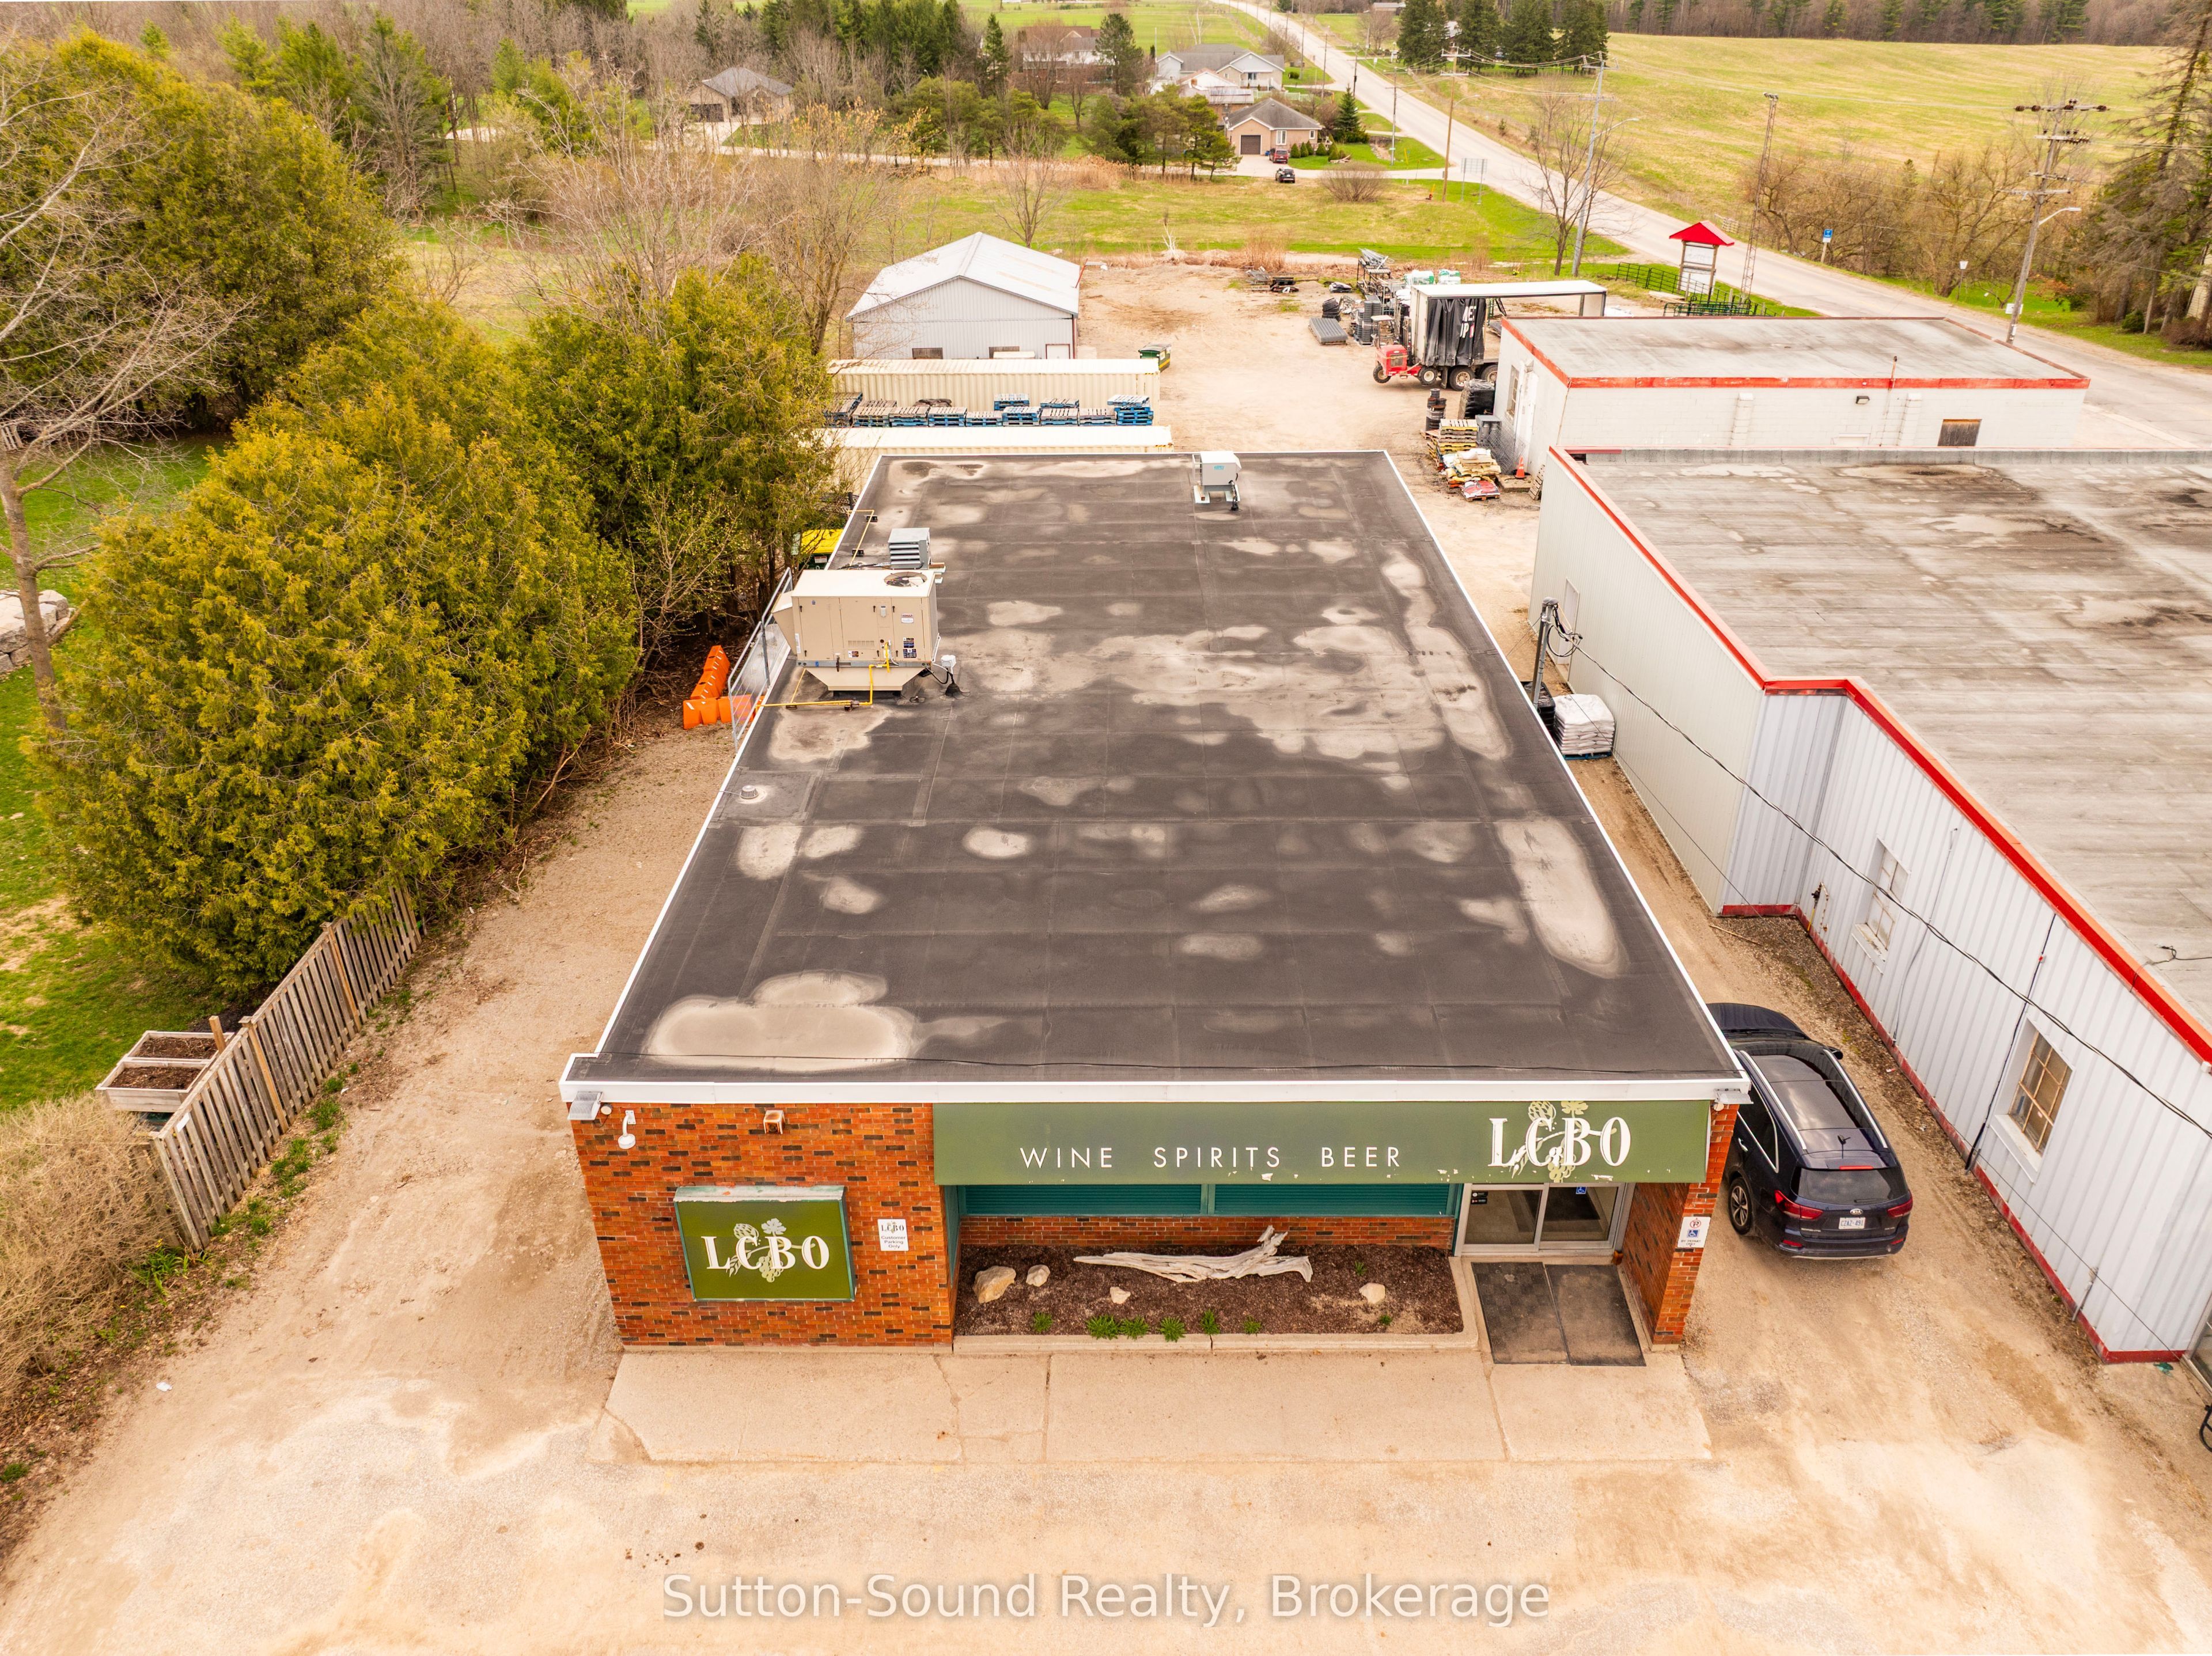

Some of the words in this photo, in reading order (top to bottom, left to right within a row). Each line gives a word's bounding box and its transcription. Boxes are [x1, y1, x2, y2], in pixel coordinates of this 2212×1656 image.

[1020, 1147, 1112, 1169] WINE
[1154, 1147, 1280, 1168] SPIRITS
[1321, 1147, 1400, 1168] BEER
[1488, 1117, 1631, 1166] LCBO
[701, 1236, 830, 1270] LCBO
